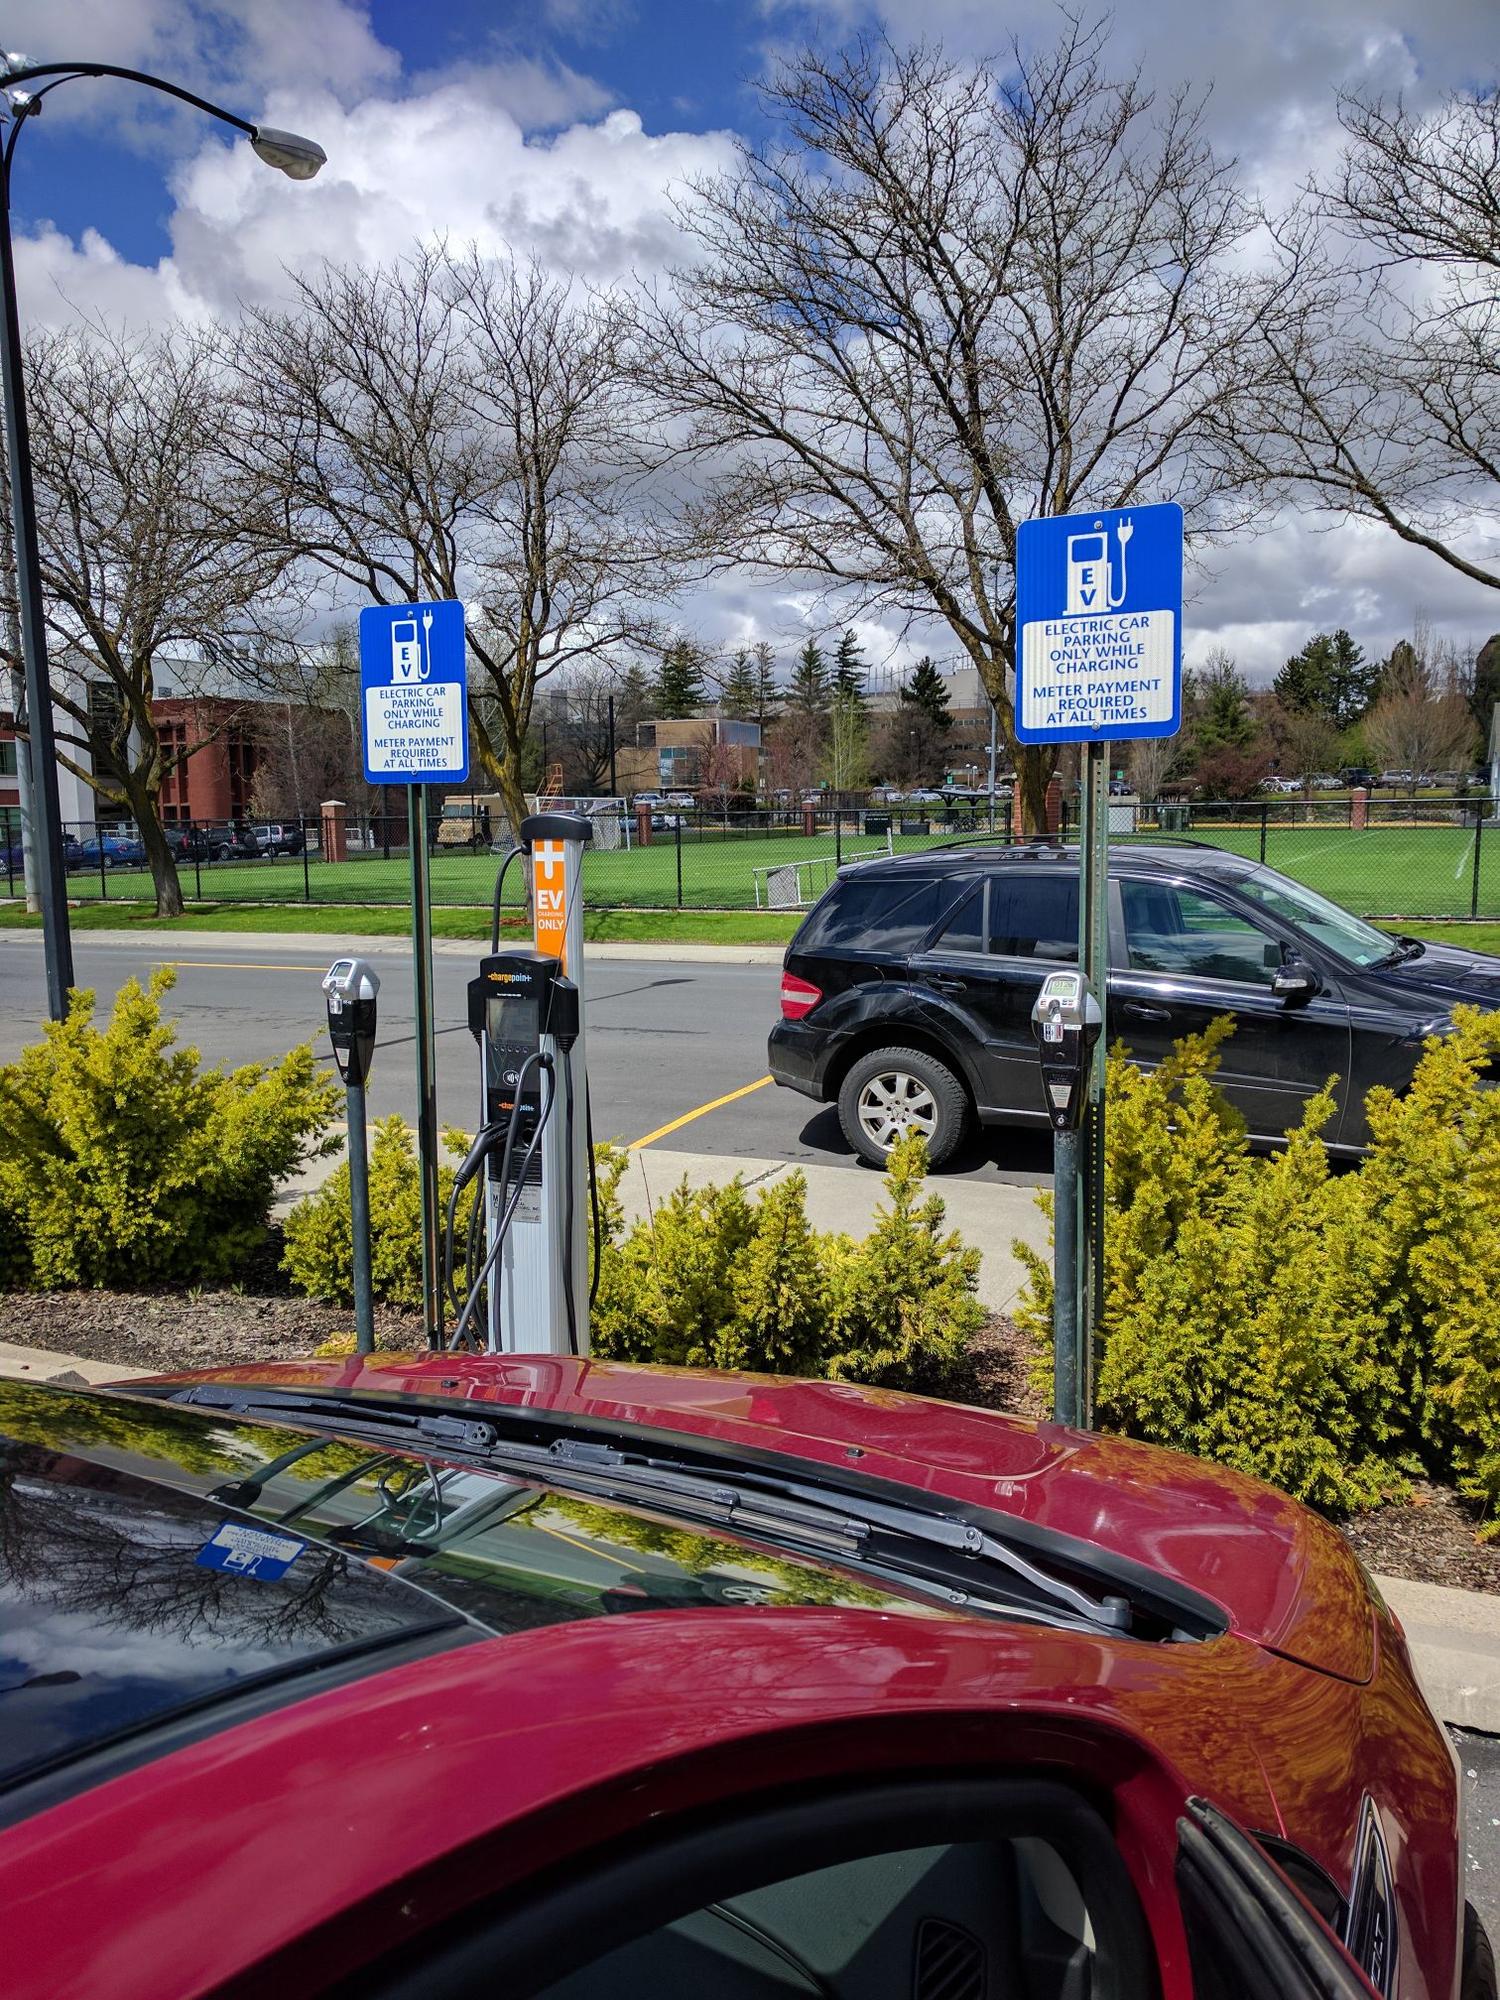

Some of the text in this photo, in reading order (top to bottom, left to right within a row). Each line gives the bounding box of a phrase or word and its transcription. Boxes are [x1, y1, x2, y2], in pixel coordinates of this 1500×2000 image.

[1045, 616, 1150, 636] ELECTRIC CAR
[1064, 631, 1130, 647] PARKING
[1050, 643, 1145, 661] ONLY WHILE
[1056, 657, 1138, 674] CHARGING
[380, 687, 446, 699] ELECTRIC CAR
[1033, 679, 1161, 698] METER PAYMENT
[392, 698, 434, 708] PARKING
[1059, 695, 1134, 710] REQUIRED
[384, 708, 444, 719] ONLY WHILE
[1046, 707, 1147, 723] AT ALL TIMES
[388, 719, 440, 729] CHARGING
[374, 736, 455, 748] METER PAYMENT
[391, 748, 439, 759] REQUIRED
[384, 758, 447, 768] AT ALL TIMES
[537, 889, 564, 910] EV
[537, 919, 564, 930] ONLY
